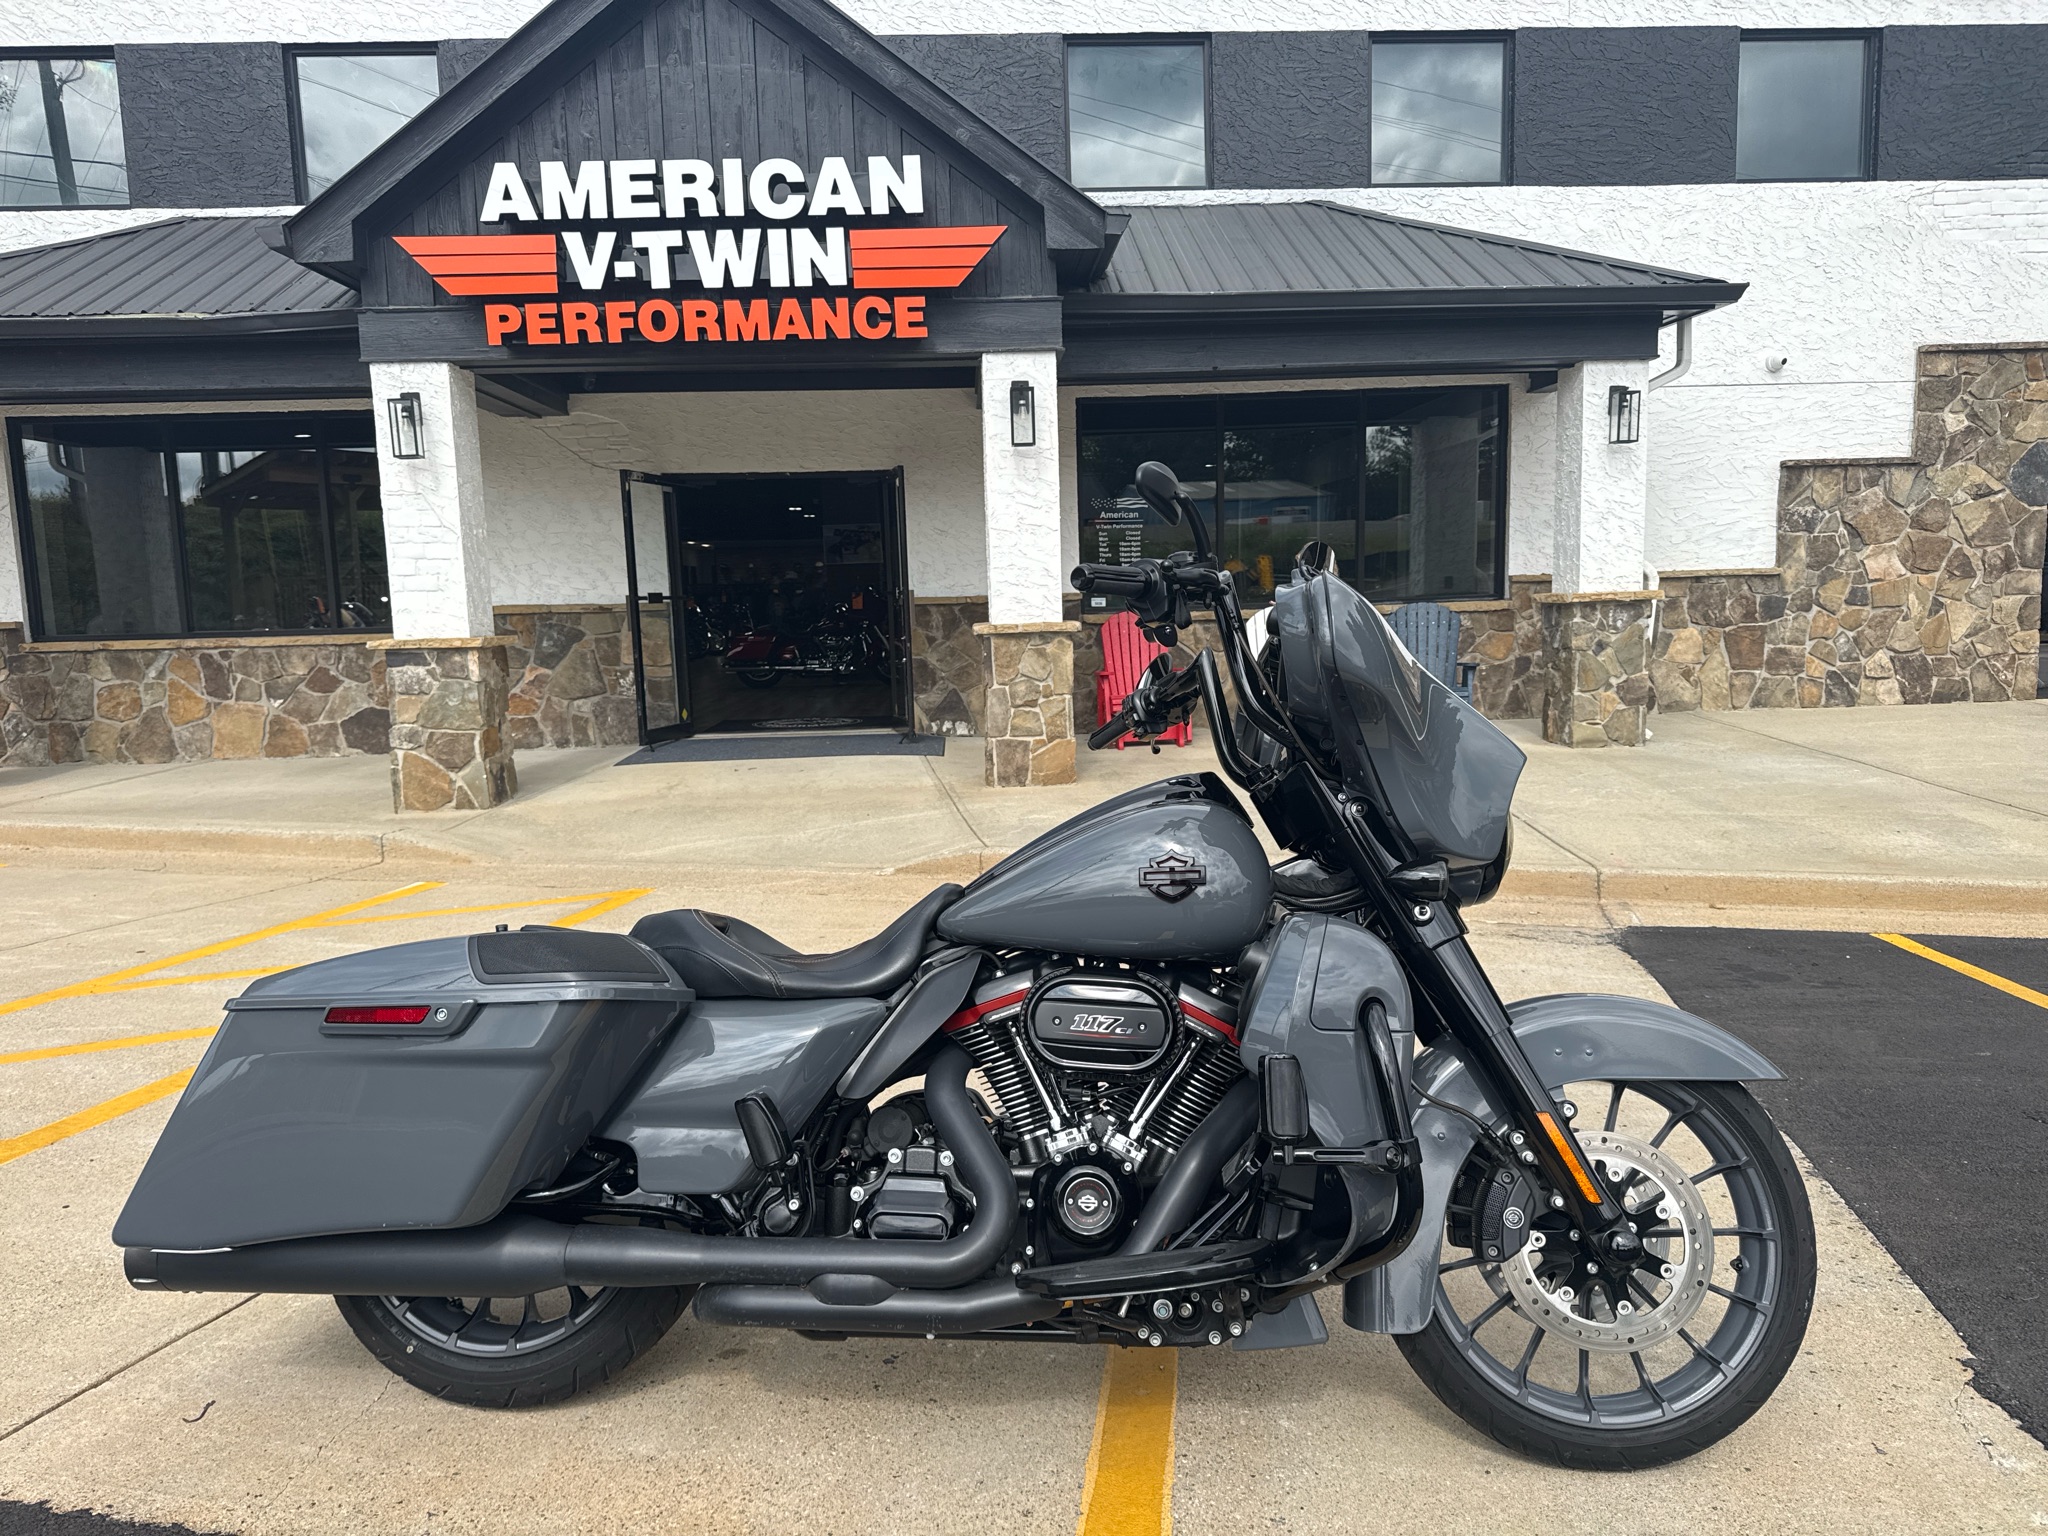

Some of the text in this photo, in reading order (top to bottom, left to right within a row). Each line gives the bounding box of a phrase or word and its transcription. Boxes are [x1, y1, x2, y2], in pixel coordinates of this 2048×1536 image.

[480, 155, 924, 222] AMERICAN
[561, 227, 848, 290] V-TWIN
[485, 296, 928, 345] PERFORMANCE
[1100, 511, 1139, 519] American
[1070, 1013, 1124, 1033] 117
